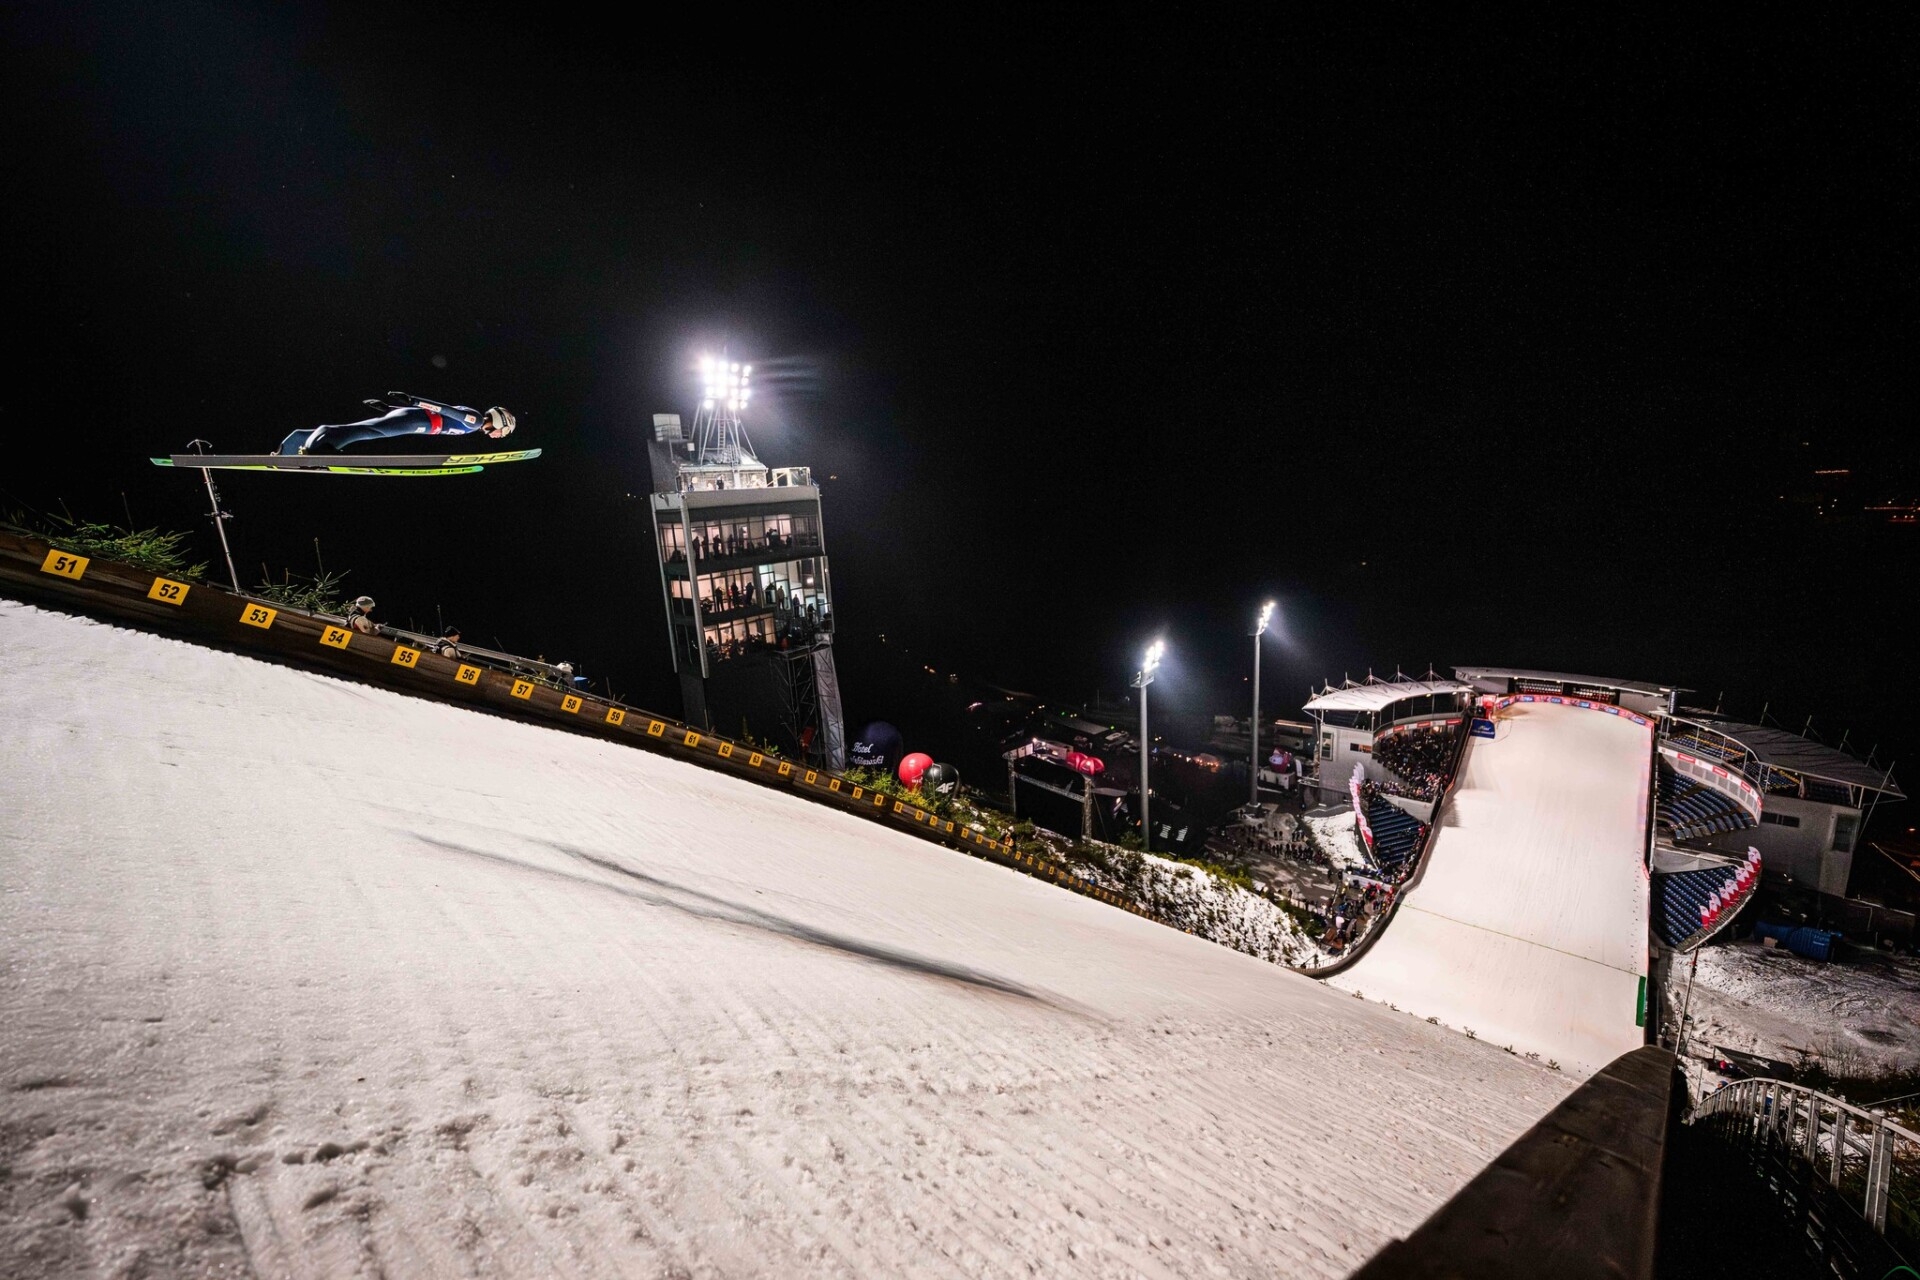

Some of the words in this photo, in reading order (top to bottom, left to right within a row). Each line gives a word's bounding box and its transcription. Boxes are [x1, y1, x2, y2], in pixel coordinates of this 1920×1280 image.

[54, 556, 77, 573] 51
[158, 584, 180, 600] 52
[250, 609, 268, 624] 53
[327, 630, 345, 645] 54
[399, 651, 413, 664] 55
[461, 669, 475, 681] 56
[516, 684, 529, 696] 57
[566, 699, 577, 710] 58
[610, 711, 621, 722] 59
[651, 724, 661, 734] 60
[688, 734, 697, 744] 61
[721, 745, 730, 754] 62
